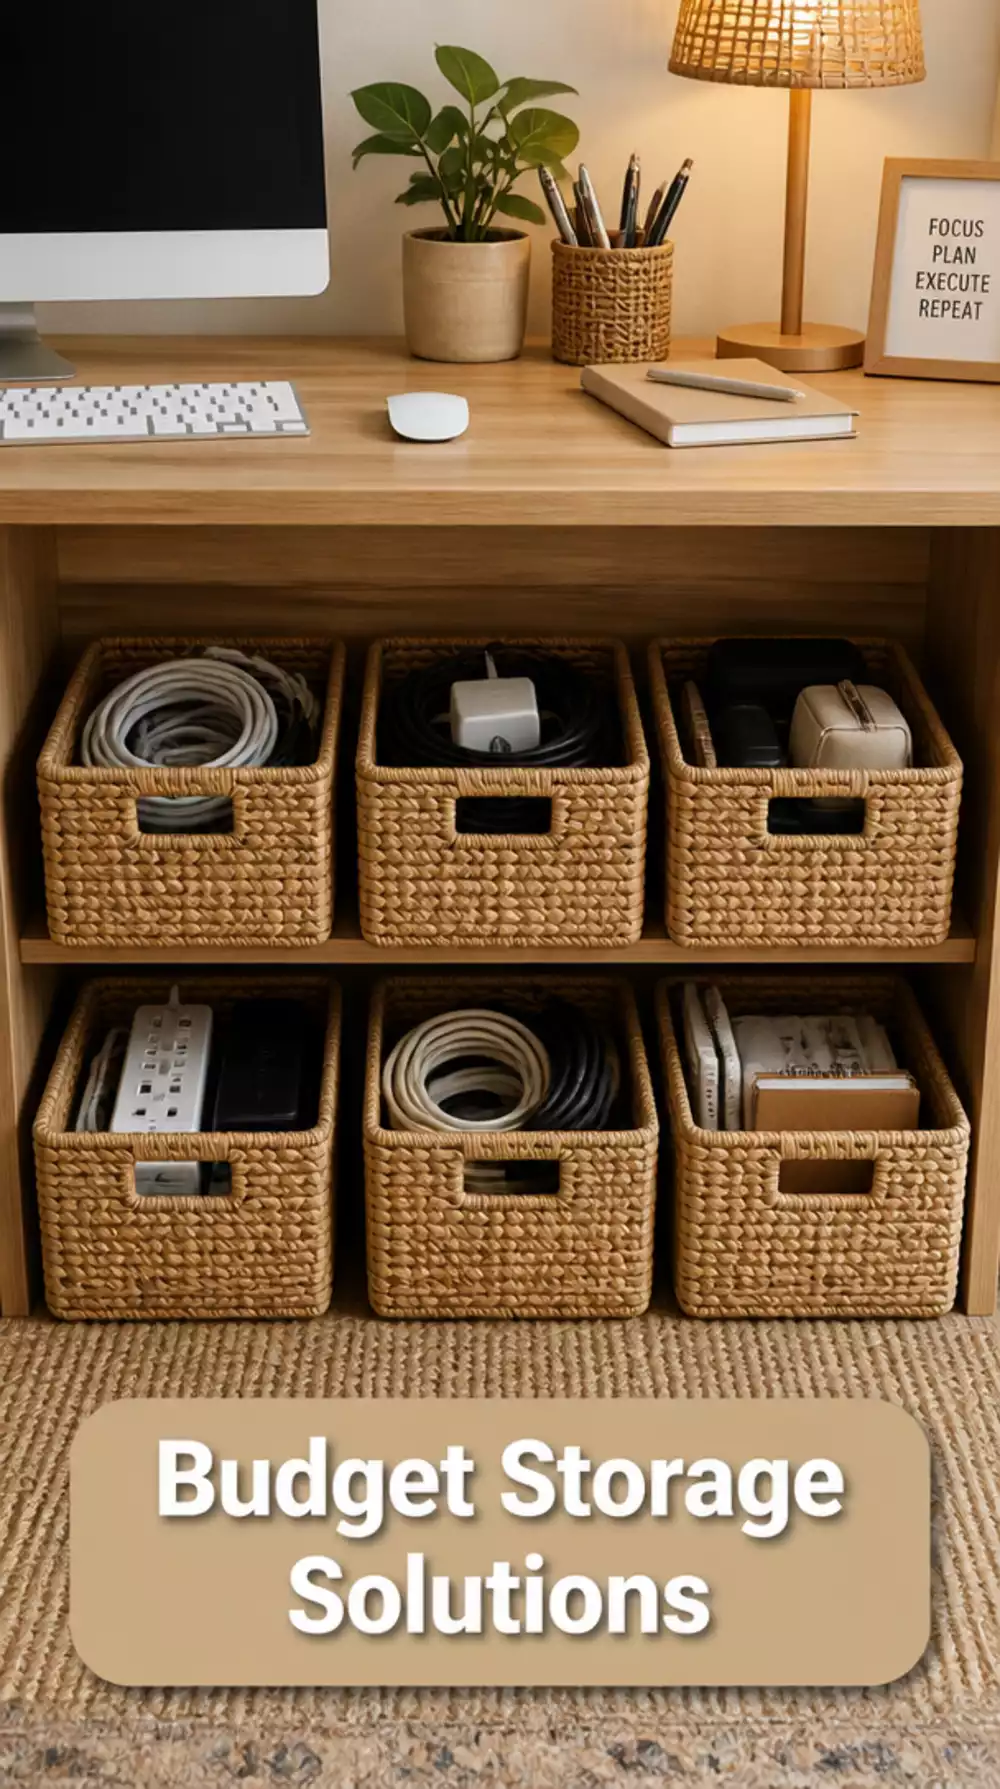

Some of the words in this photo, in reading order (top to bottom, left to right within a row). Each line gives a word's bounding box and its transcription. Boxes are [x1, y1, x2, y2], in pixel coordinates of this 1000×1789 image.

[928, 218, 985, 238] FOCUS
[932, 245, 977, 265] PLAN
[915, 271, 991, 293] EXECUTE
[918, 299, 983, 320] REPEAT
